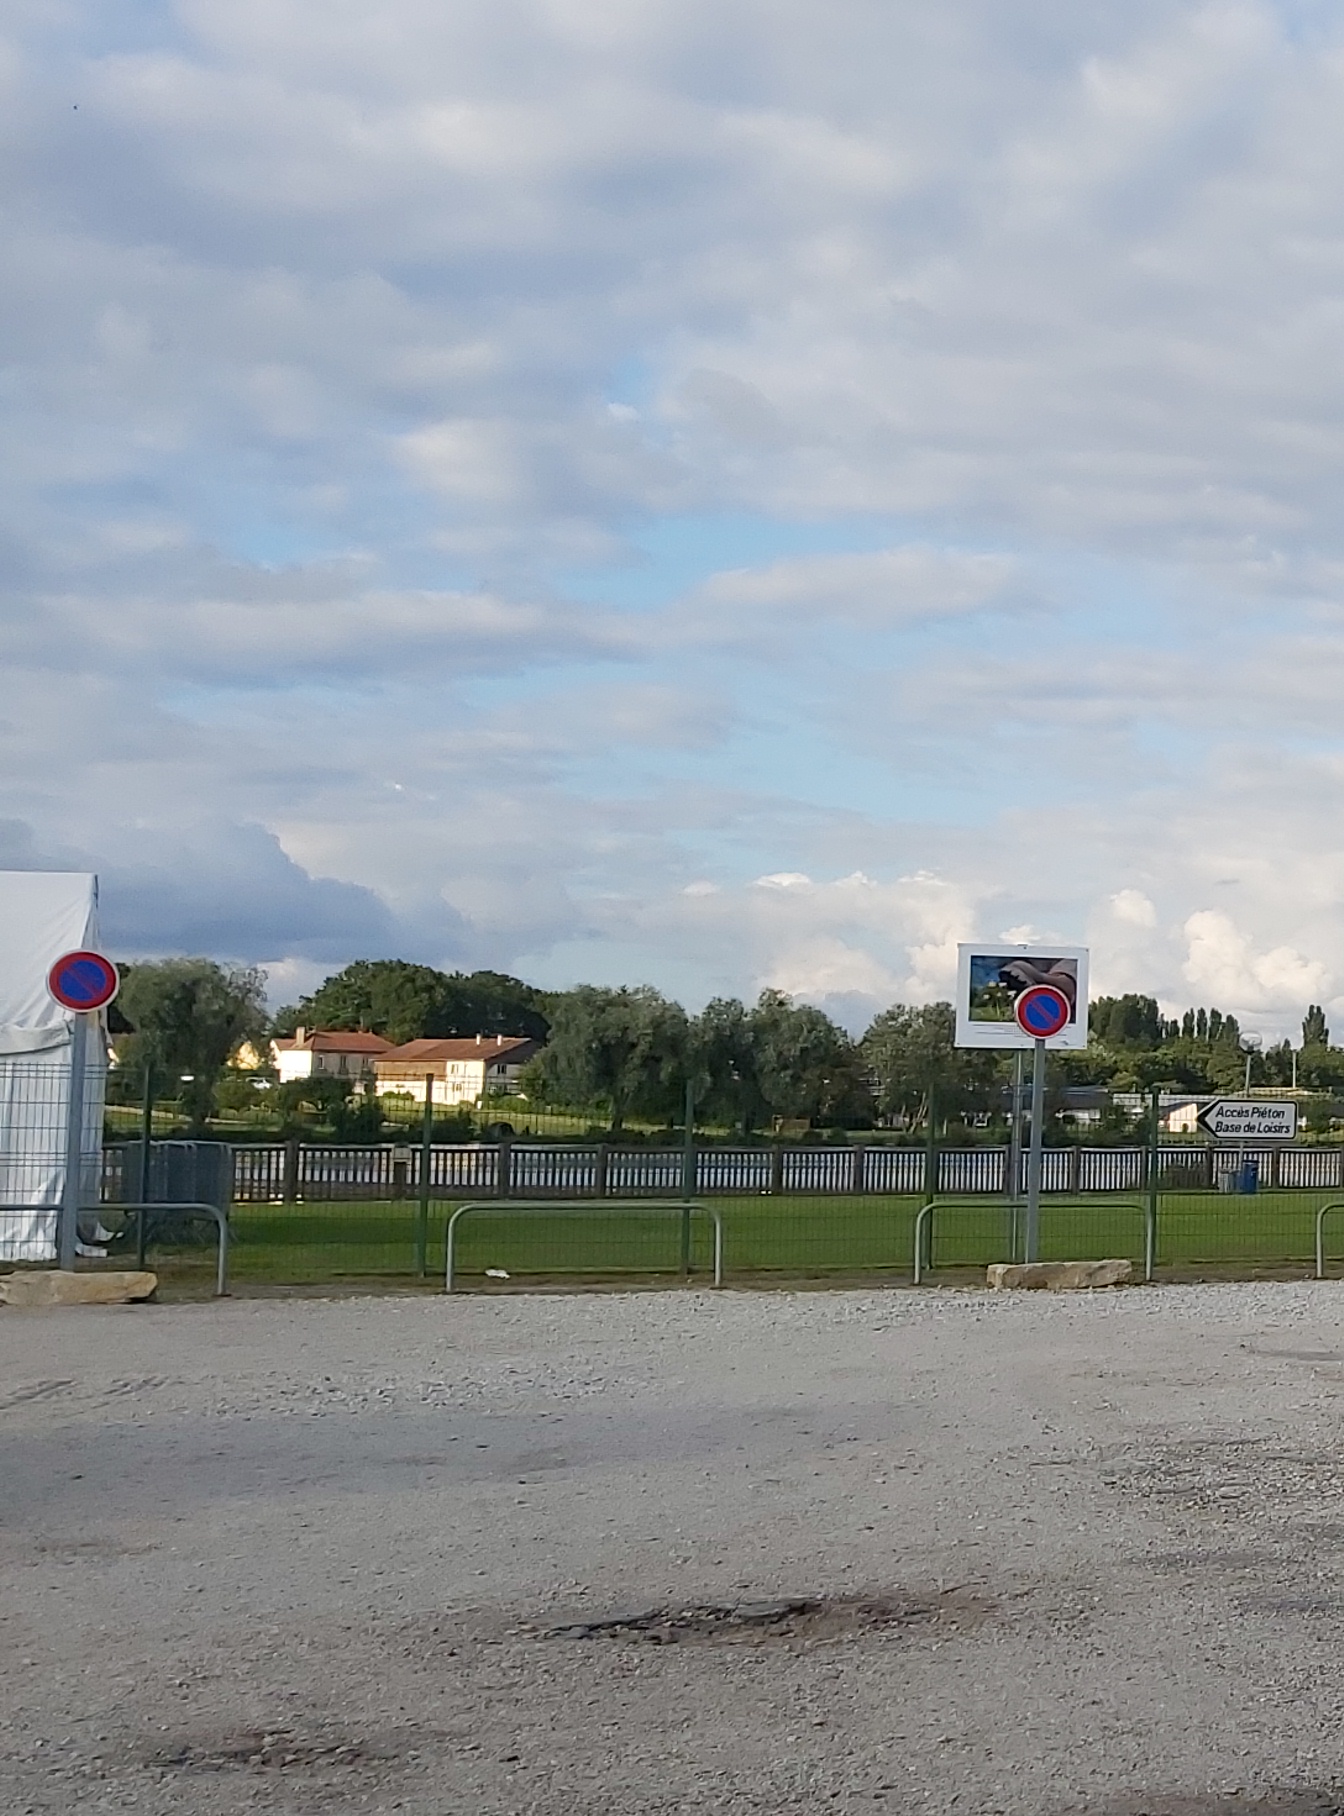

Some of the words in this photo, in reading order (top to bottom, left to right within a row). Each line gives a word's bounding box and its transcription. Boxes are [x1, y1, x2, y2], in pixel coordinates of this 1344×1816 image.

[1215, 1106, 1250, 1118] Accès
[1250, 1106, 1285, 1119] Piéton
[1215, 1121, 1242, 1133] Base
[1243, 1121, 1256, 1133] de
[1257, 1121, 1291, 1134] Loisirs
